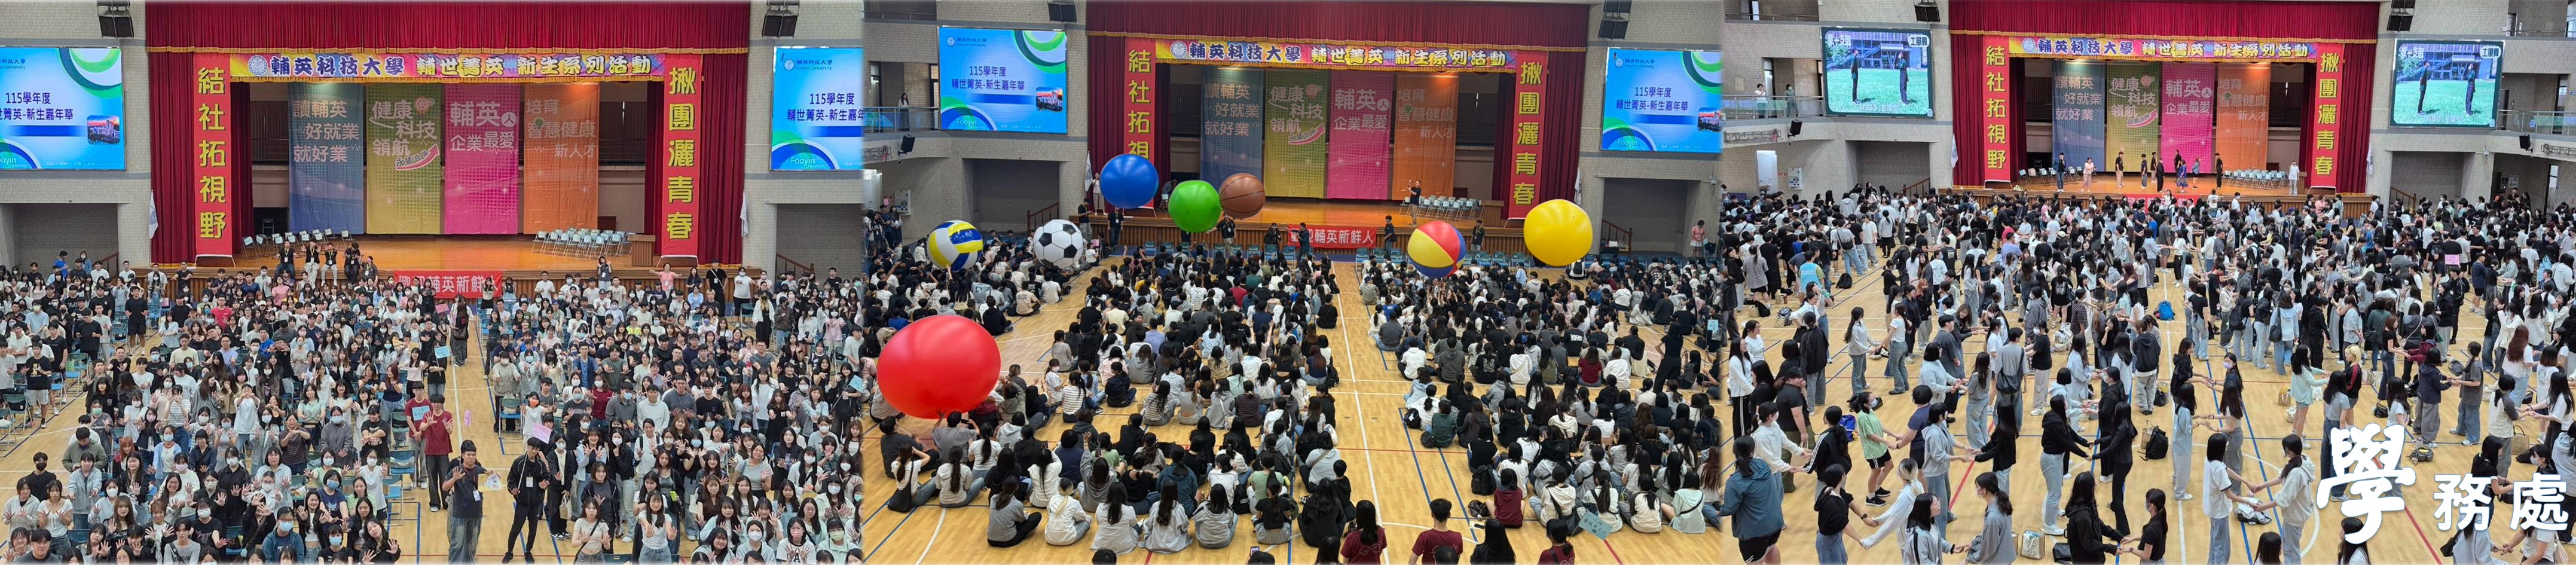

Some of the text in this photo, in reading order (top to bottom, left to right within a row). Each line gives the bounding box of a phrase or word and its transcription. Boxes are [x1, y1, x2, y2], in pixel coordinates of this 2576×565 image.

[1188, 42, 1507, 67] 輔英科技大學 輔世菁英 新生系列活動
[2038, 38, 2309, 58] 輔英科技大學 輔世菁英 新生系列活動
[270, 55, 651, 76] 輔英科技大學 輔世菁英 新生系列活動
[969, 66, 1006, 77] 115學年度
[952, 78, 1025, 90] 輔世菁英-新生嘉年華
[2055, 76, 2094, 89] 讀輔英
[2111, 77, 2140, 91] 健康
[2219, 78, 2242, 90] 培育
[6, 92, 51, 104] 115學年度
[1205, 83, 1250, 99] 讀輔英
[1270, 85, 1304, 102] 健康
[1397, 88, 1426, 101] 培育
[1635, 87, 1672, 97] 115學年度
[2064, 92, 2102, 105] 好就業
[526, 99, 559, 114] 培育
[810, 93, 854, 105] 115學年度
[1616, 99, 1688, 111] 輔世菁英-新生嘉年華
[2127, 92, 2156, 106] 科技
[294, 100, 347, 118] 讀輔英
[372, 99, 413, 120] 健康
[1215, 102, 1260, 118] 好就業
[1290, 103, 1324, 120] 科技
[1986, 45, 2006, 169] 結社拓視野
[2055, 108, 2094, 121] 就好業
[2111, 105, 2138, 117] 領航
[2165, 100, 2210, 115] 企業最愛
[2314, 53, 2339, 175] 揪團灑青春
[1334, 114, 1387, 130] 企業最愛
[2238, 110, 2268, 121] 新人才
[305, 123, 359, 140] 好就業
[396, 121, 438, 139] 科技
[528, 120, 596, 139] 智慧健康
[1205, 121, 1249, 136] 就好業
[1270, 118, 1301, 133] 領航
[1420, 126, 1455, 138] 新人才
[1513, 61, 1542, 205] 揪團灑青春
[372, 139, 410, 156] 領航
[450, 131, 514, 152] 企業最愛
[1618, 139, 1637, 148] Fooyin
[198, 67, 225, 239] 結社拓視野
[294, 145, 347, 163] 就好業
[554, 143, 597, 158] 新人才
[667, 67, 695, 239] 揪團灑青春
[791, 157, 815, 166] Fooyin
